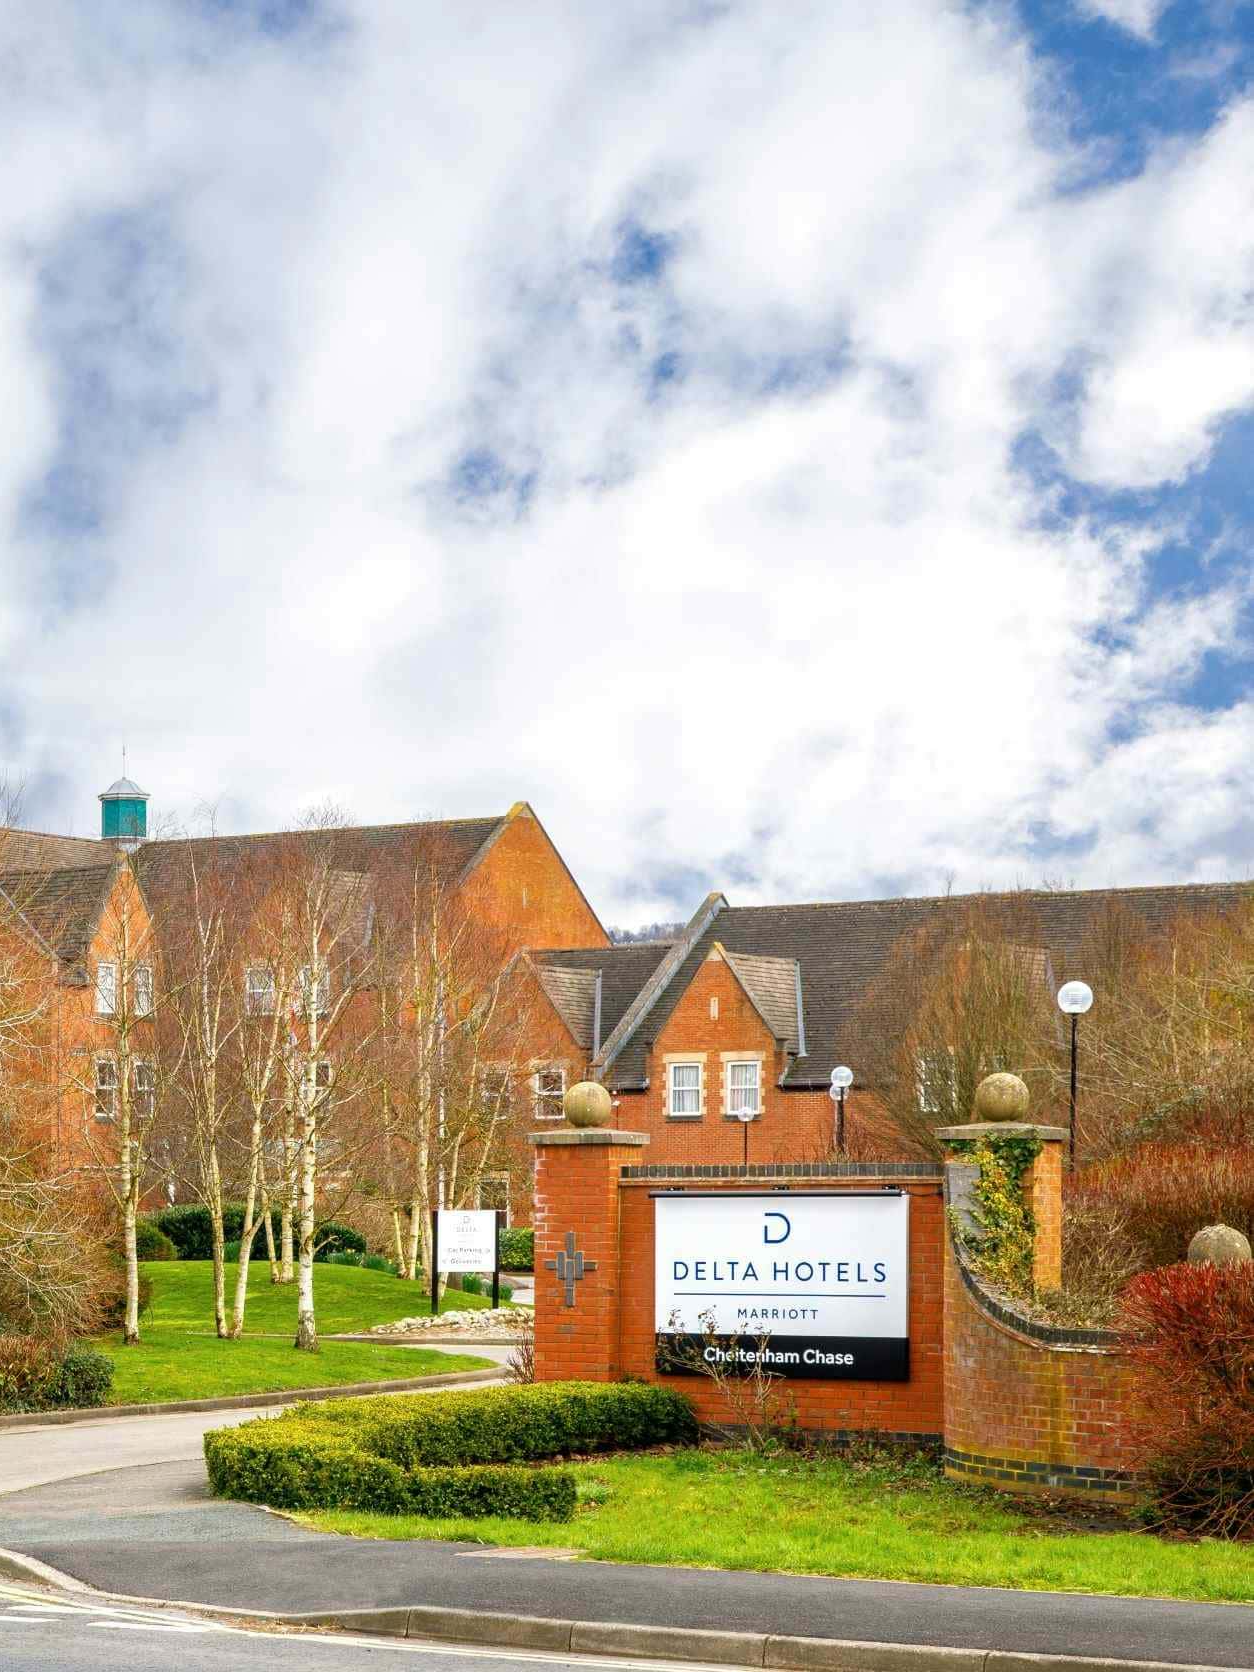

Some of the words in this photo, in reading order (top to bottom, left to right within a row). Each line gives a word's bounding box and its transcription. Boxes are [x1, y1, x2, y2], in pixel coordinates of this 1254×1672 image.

[764, 1212, 791, 1244] D
[673, 1261, 759, 1281] DELTA
[773, 1261, 886, 1283] HOTELS
[737, 1308, 819, 1320] MARRIOTT
[802, 1348, 854, 1365] Chase
